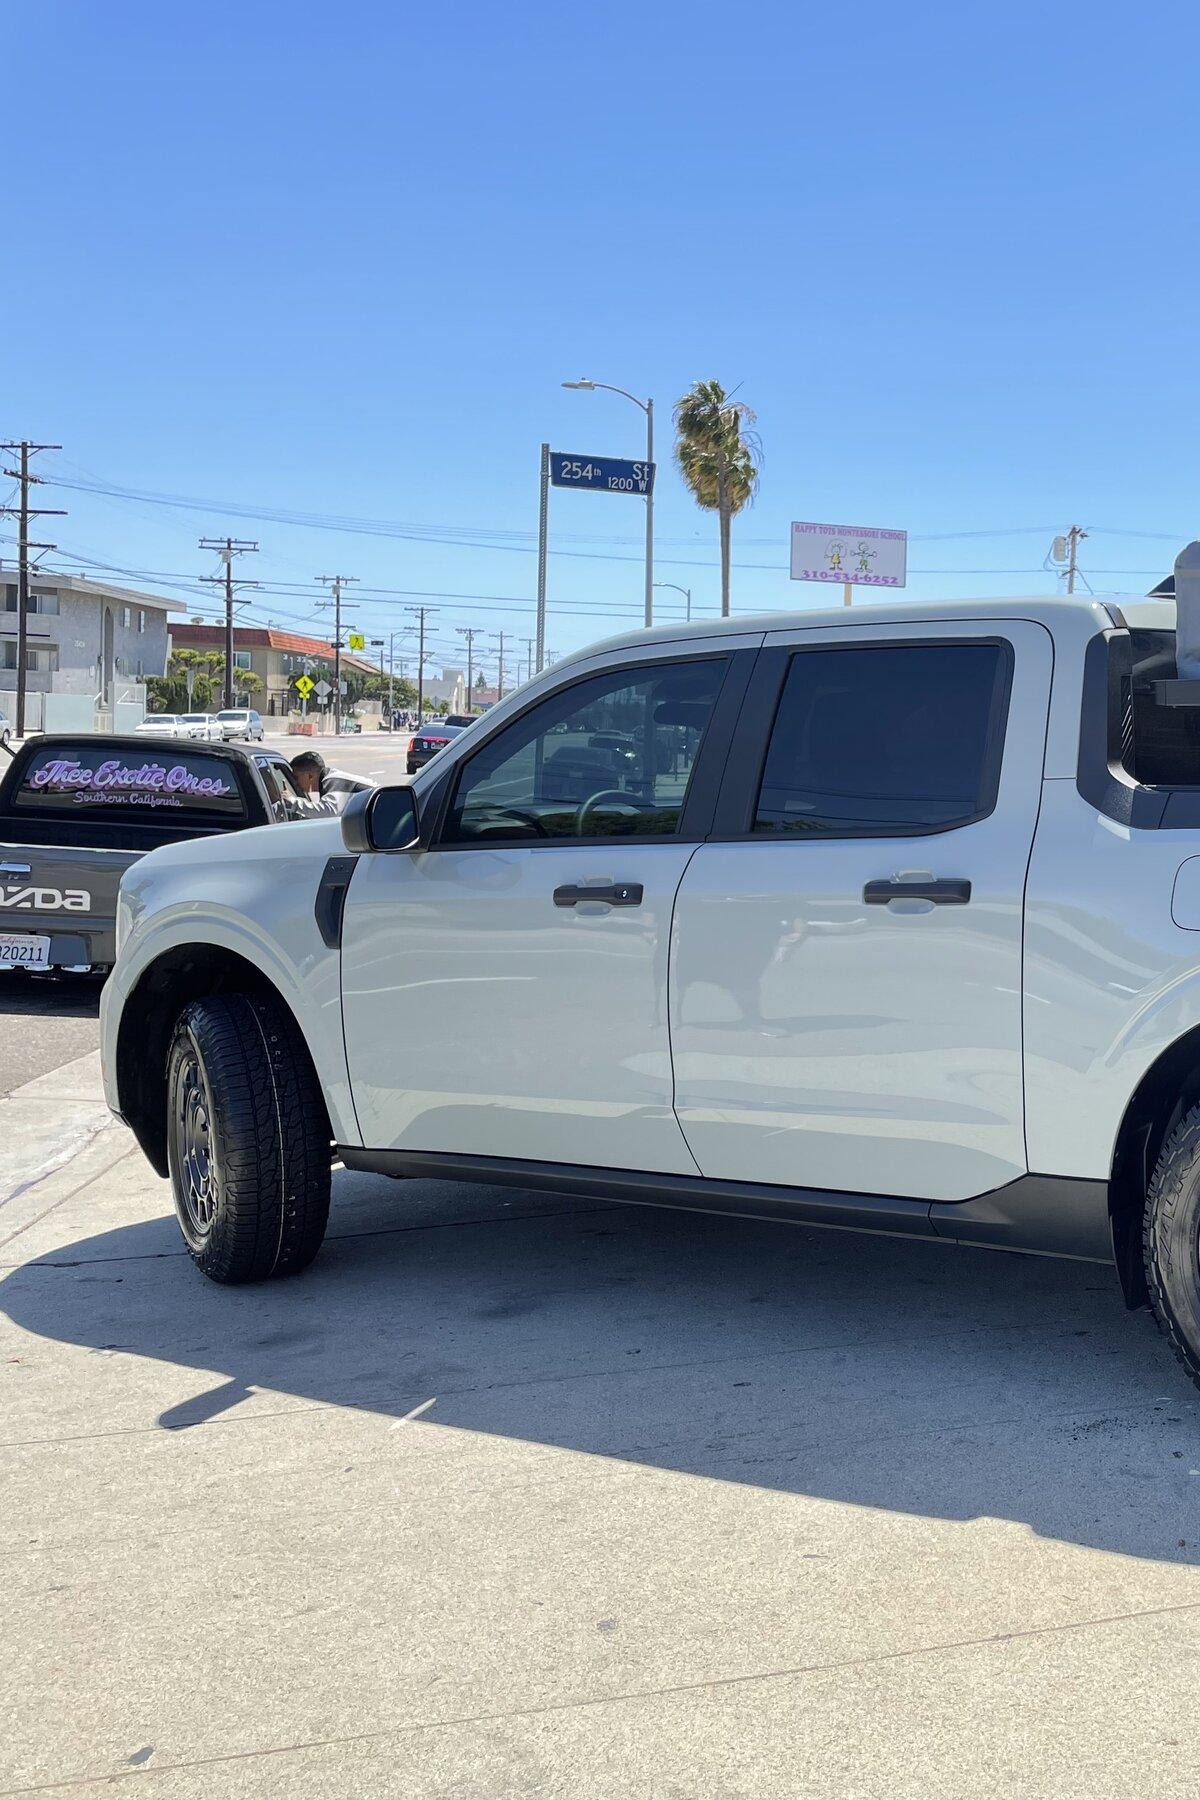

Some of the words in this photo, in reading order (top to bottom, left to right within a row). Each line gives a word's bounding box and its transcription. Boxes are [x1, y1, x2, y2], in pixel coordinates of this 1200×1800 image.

[561, 461, 602, 480] 254th
[632, 463, 650, 480] St
[608, 477, 633, 490] 1200
[638, 479, 648, 492] W
[801, 569, 899, 585] 310-534-6252
[92, 760, 166, 788] Exotic
[165, 766, 230, 796] Ones
[73, 791, 127, 804] Southern
[129, 793, 183, 808] California
[0, 945, 43, 962] 20211
